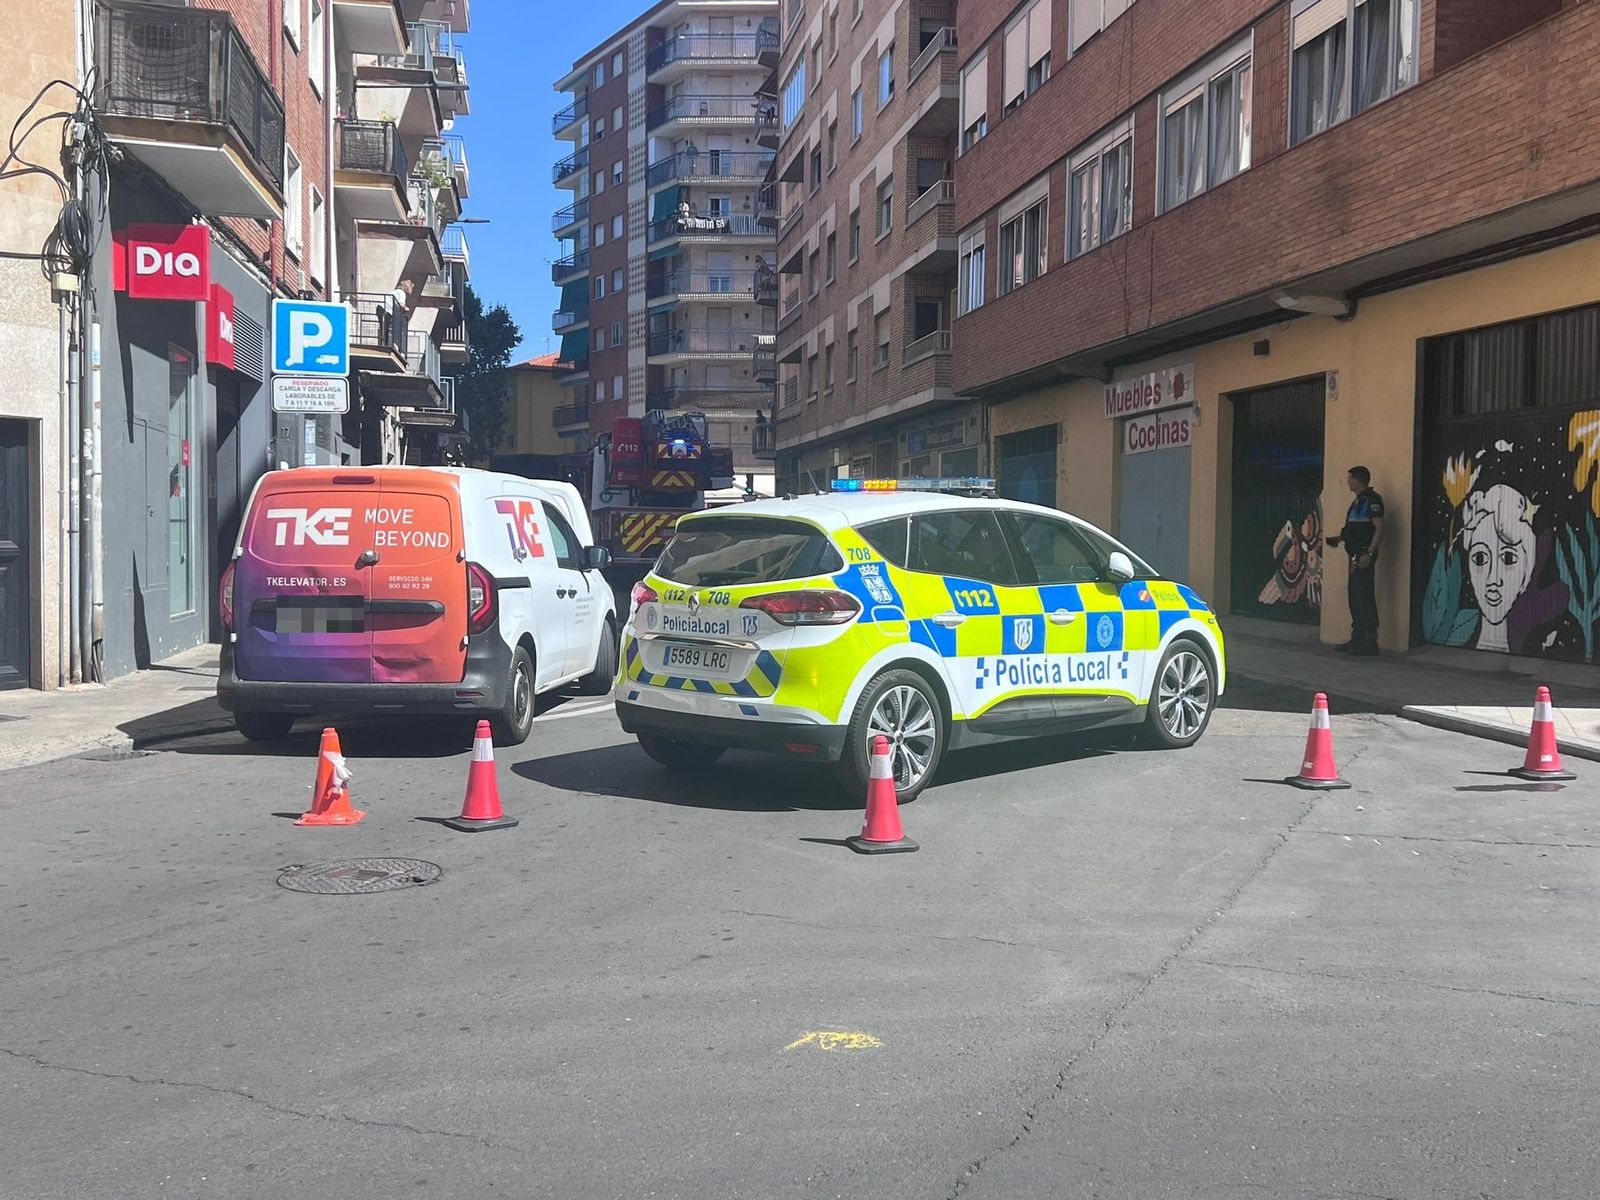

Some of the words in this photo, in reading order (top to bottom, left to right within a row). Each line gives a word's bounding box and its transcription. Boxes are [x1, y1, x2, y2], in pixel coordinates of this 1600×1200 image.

[290, 310, 333, 364] P
[1105, 379, 1162, 415] Muebles
[1128, 417, 1189, 450] Cocinas
[624, 443, 640, 452] 112
[364, 508, 415, 524] MOVE
[266, 507, 353, 546] TKE
[374, 530, 450, 548] BEYOND
[847, 547, 872, 561] 708
[266, 576, 347, 587] TKELEVATOR.ES
[667, 589, 686, 601] 112
[707, 591, 731, 605] 708
[960, 588, 994, 607] 112
[671, 648, 701, 666] 5589
[703, 651, 728, 669] LRC
[1067, 655, 1111, 683] Local
